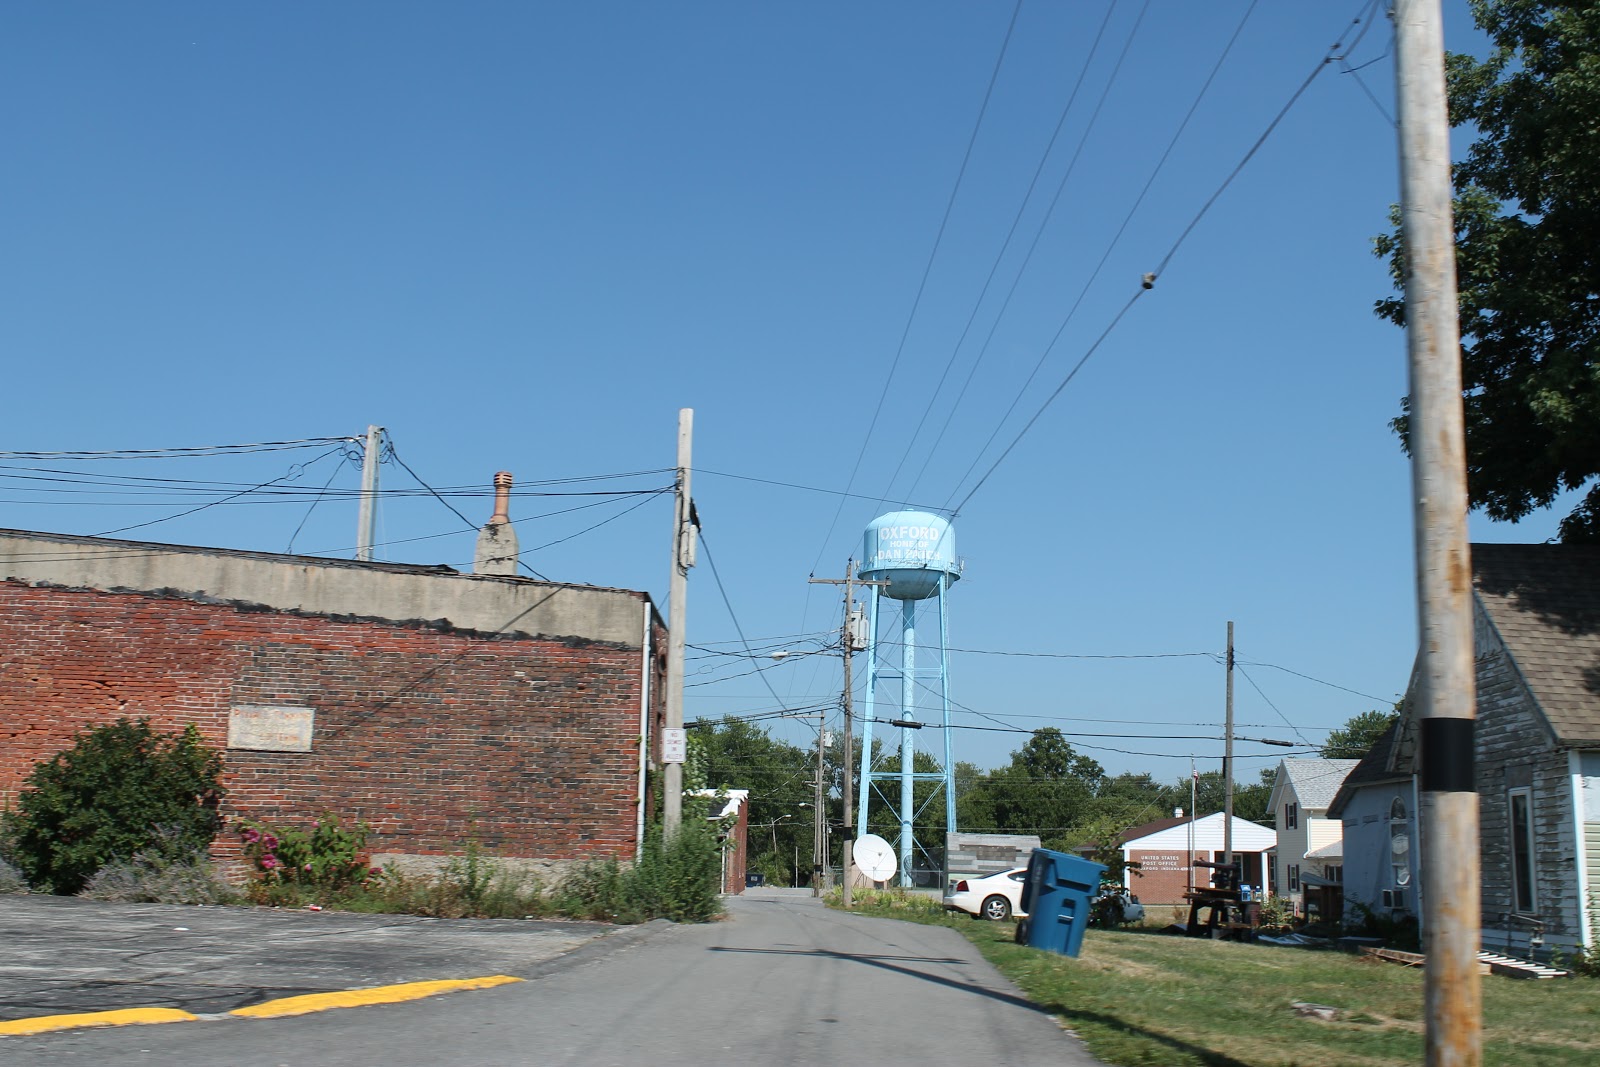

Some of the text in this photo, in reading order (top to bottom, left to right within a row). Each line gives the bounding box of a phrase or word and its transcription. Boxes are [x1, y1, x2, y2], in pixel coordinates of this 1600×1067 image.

[881, 525, 939, 540] OXFORD
[890, 540, 930, 548] HOME OF
[878, 549, 941, 560] DAN PATCH
